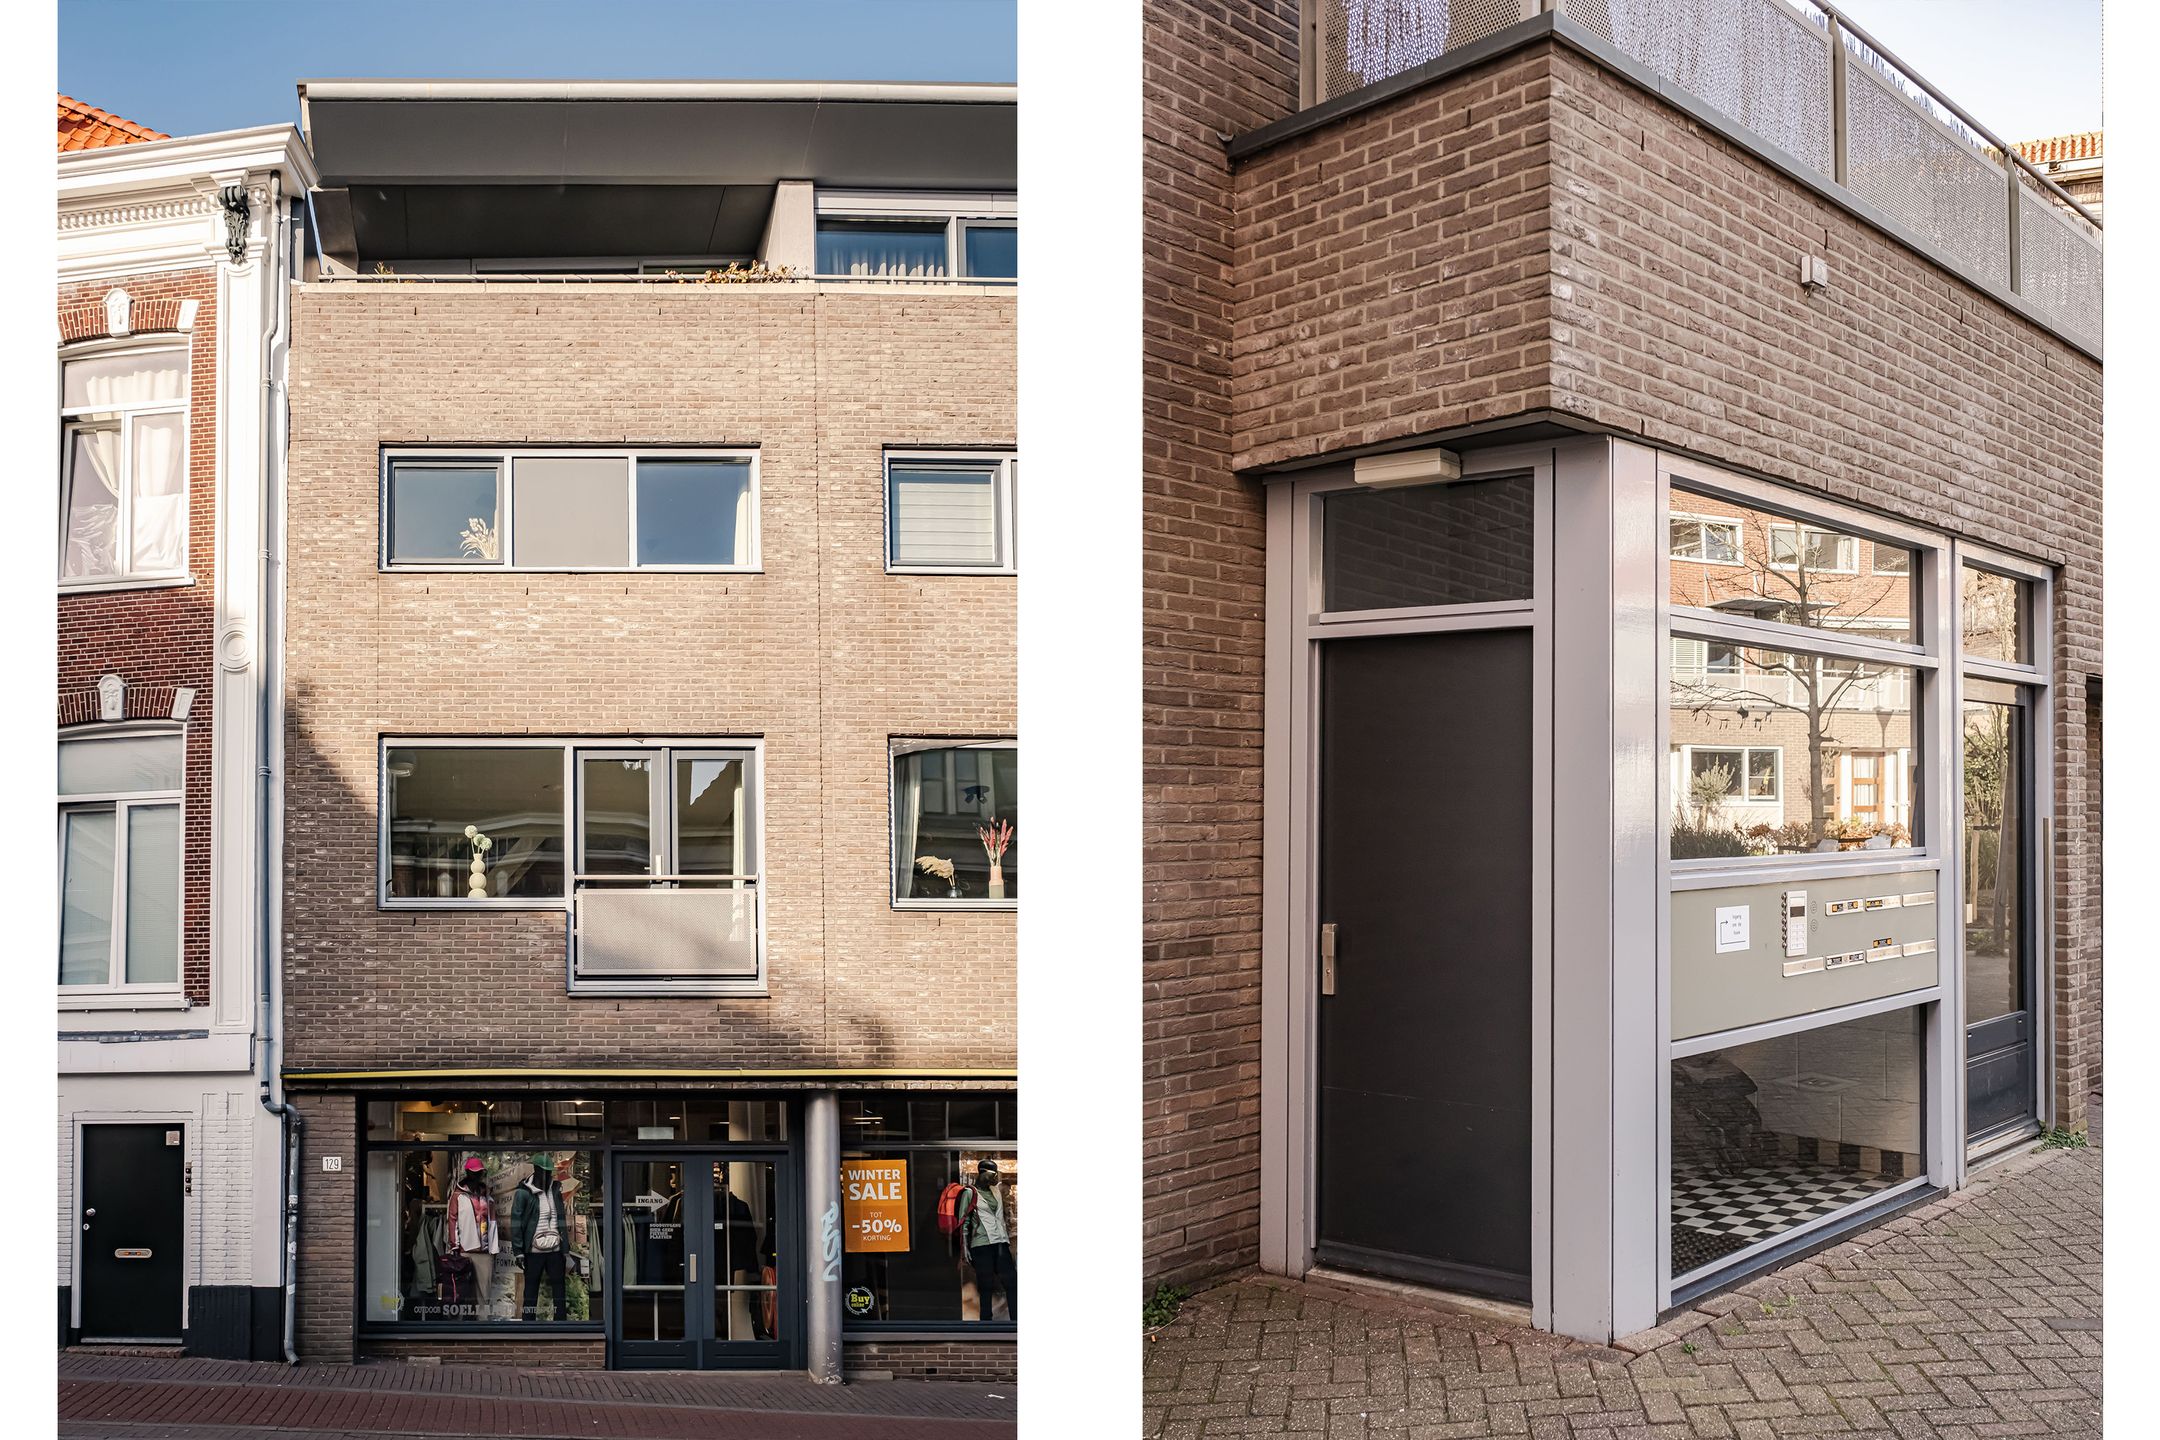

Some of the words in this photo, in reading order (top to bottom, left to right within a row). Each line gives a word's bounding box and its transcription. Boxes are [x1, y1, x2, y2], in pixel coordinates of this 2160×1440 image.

[325, 1158, 339, 1170] 129
[848, 1169, 901, 1181] WINTER
[849, 1182, 902, 1201] SALE
[852, 1219, 902, 1234] -50%
[863, 1234, 892, 1242] KORTING
[850, 1294, 870, 1304] Buy
